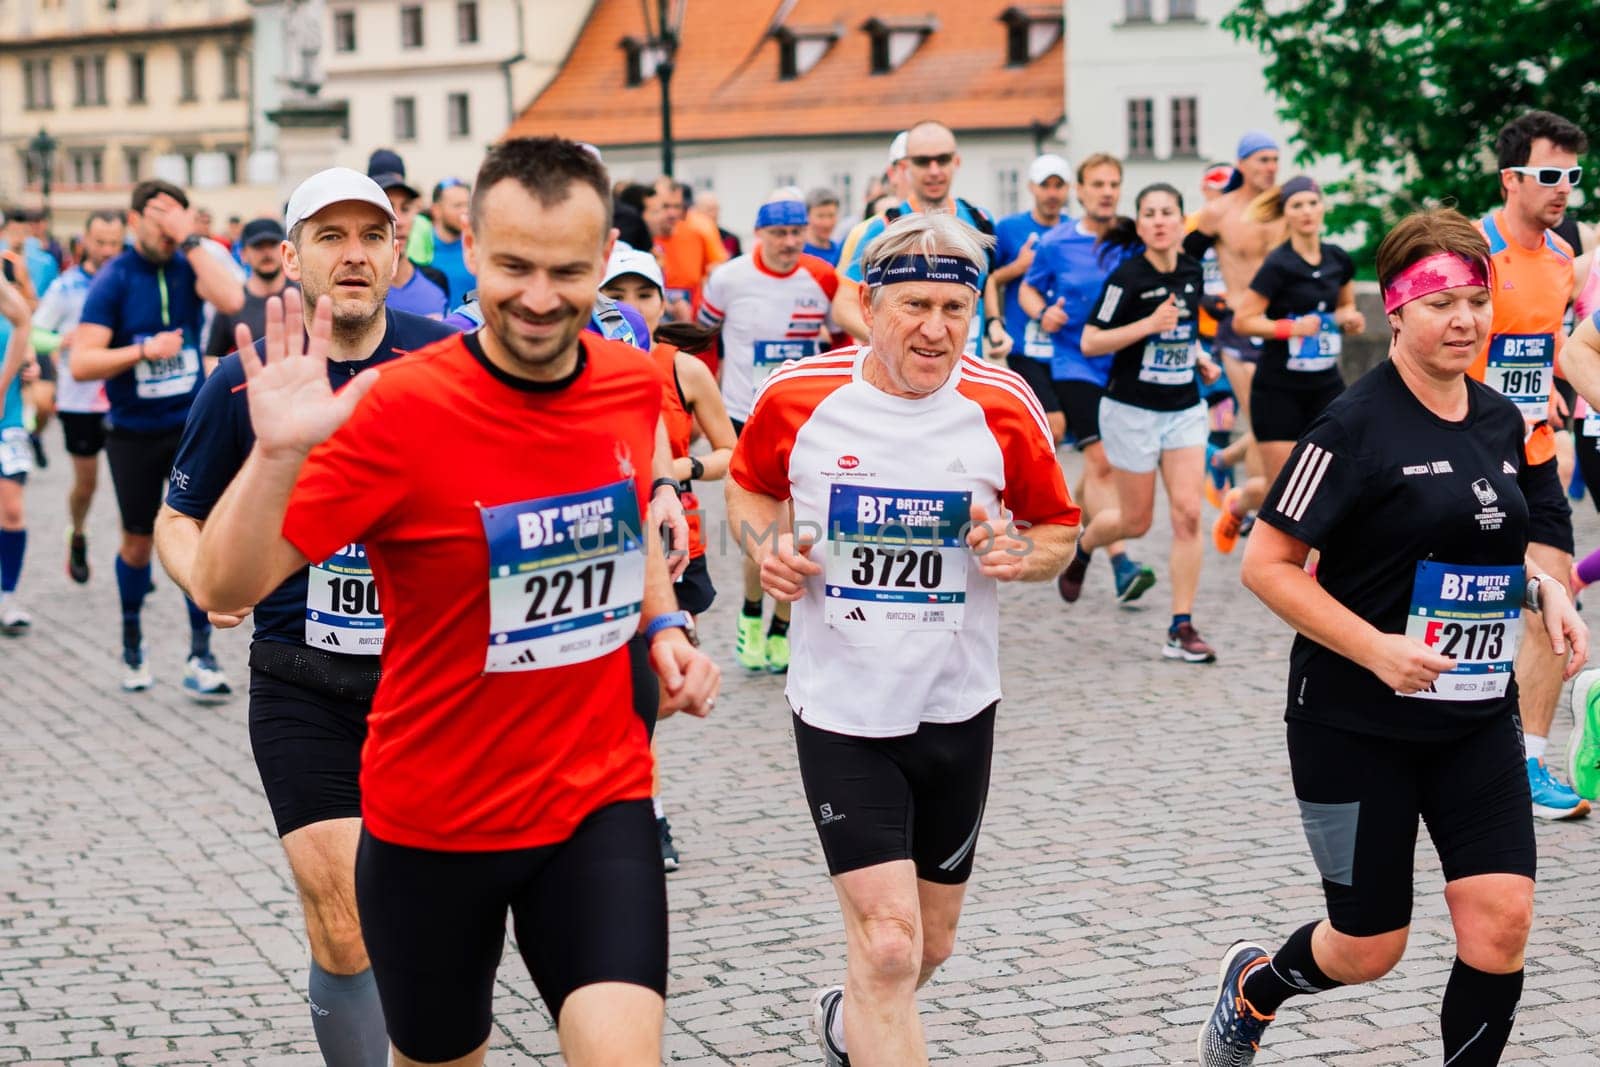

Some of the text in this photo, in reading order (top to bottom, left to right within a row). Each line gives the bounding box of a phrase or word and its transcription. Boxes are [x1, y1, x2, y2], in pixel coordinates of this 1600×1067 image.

[926, 272, 959, 280] MOIRA
[1501, 370, 1542, 394] 1916
[857, 495, 944, 525] BT. BATTLE
[899, 514, 940, 527] TEAMS
[517, 508, 565, 550] BT.
[851, 547, 943, 590] 3720
[524, 560, 615, 623] 2217
[1440, 573, 1510, 602] BT. BATTLE
[1477, 590, 1505, 602] TEAMS
